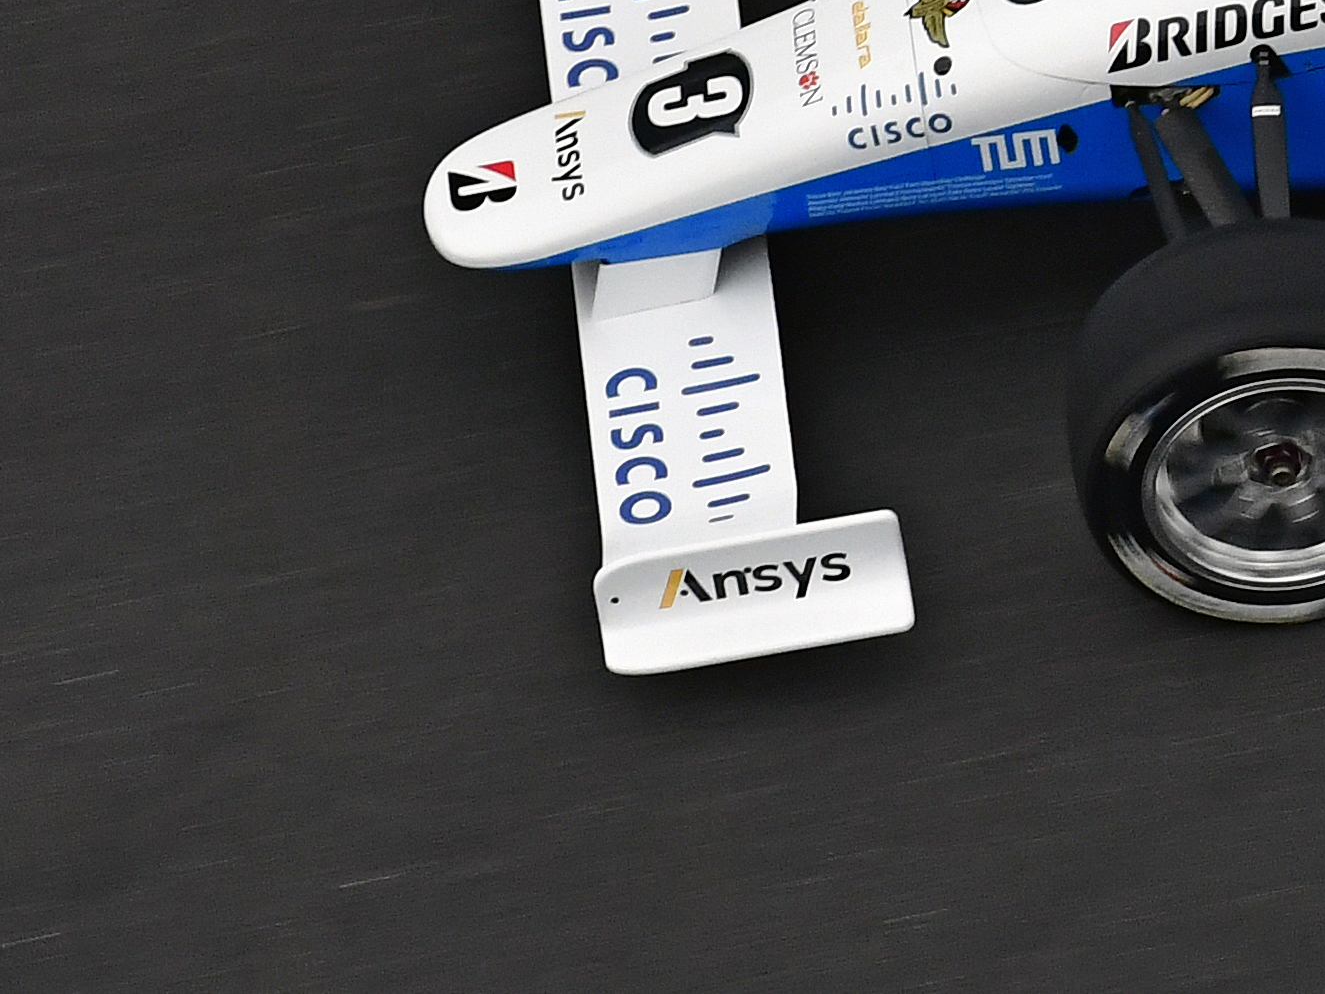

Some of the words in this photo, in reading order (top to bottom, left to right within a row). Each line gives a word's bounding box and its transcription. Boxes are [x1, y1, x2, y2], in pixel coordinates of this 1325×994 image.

[647, 76, 743, 130] 3
[551, 110, 586, 202] Ansys
[848, 113, 953, 149] CISCO
[971, 128, 1060, 172] TUM
[605, 367, 672, 525] CISCO
[659, 552, 851, 609] Ansys
